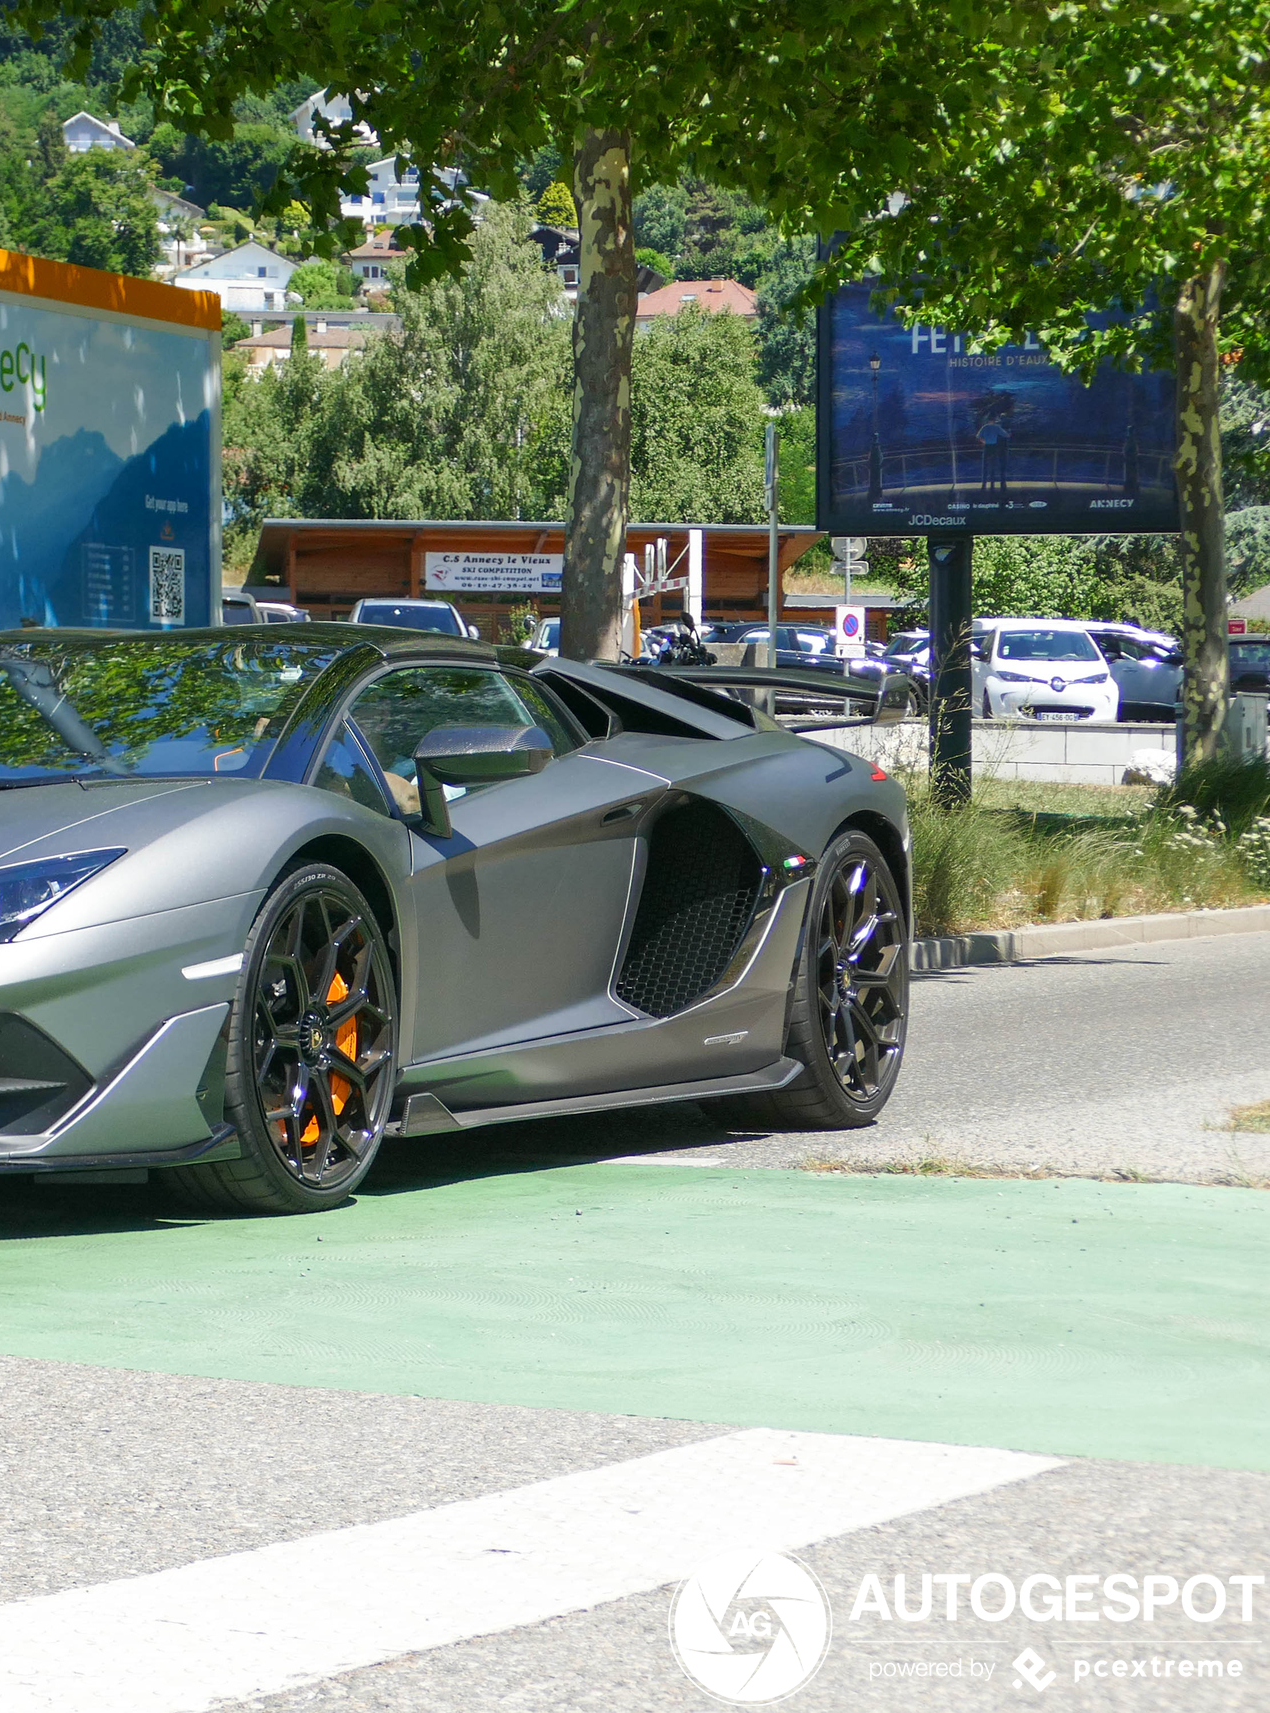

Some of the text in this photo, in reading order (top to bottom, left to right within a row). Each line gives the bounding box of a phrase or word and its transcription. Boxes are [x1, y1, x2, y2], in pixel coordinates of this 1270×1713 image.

[950, 355, 1048, 367] HISTOIRE D'EAUX
[4, 411, 26, 427] Annecy
[145, 494, 188, 514] Get your app here
[908, 515, 966, 525] JCDecaux
[443, 555, 551, 565] C.S Annecy le Vieux
